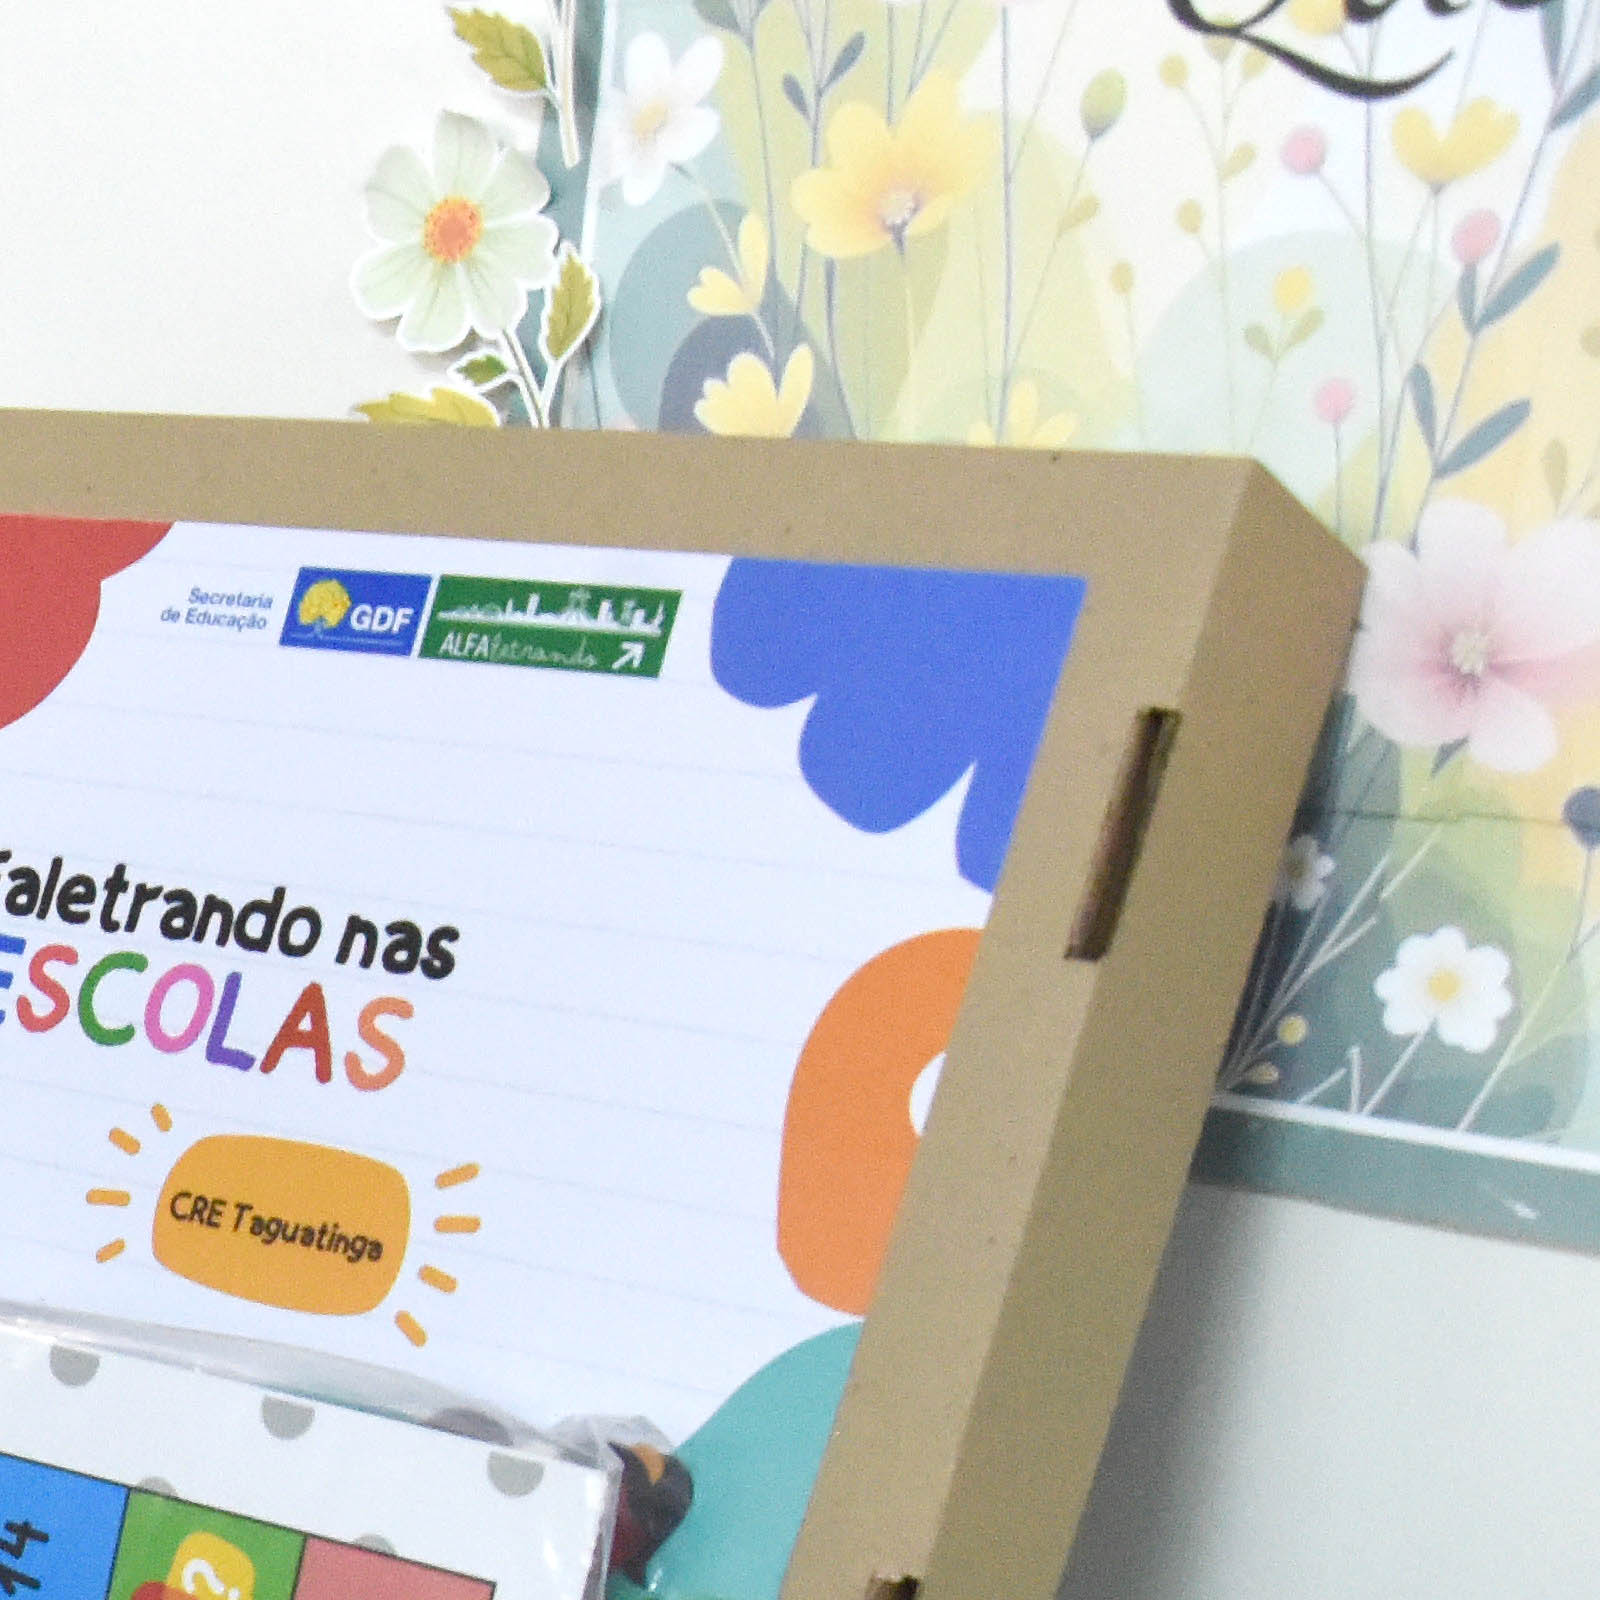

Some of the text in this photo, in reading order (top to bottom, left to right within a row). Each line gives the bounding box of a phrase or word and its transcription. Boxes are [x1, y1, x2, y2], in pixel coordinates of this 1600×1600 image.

[188, 586, 274, 612] Secretaria
[160, 606, 269, 632] de Educação
[350, 603, 415, 634] GDF
[336, 912, 461, 980] nas
[169, 1190, 385, 1264] CRE Taguatinga
